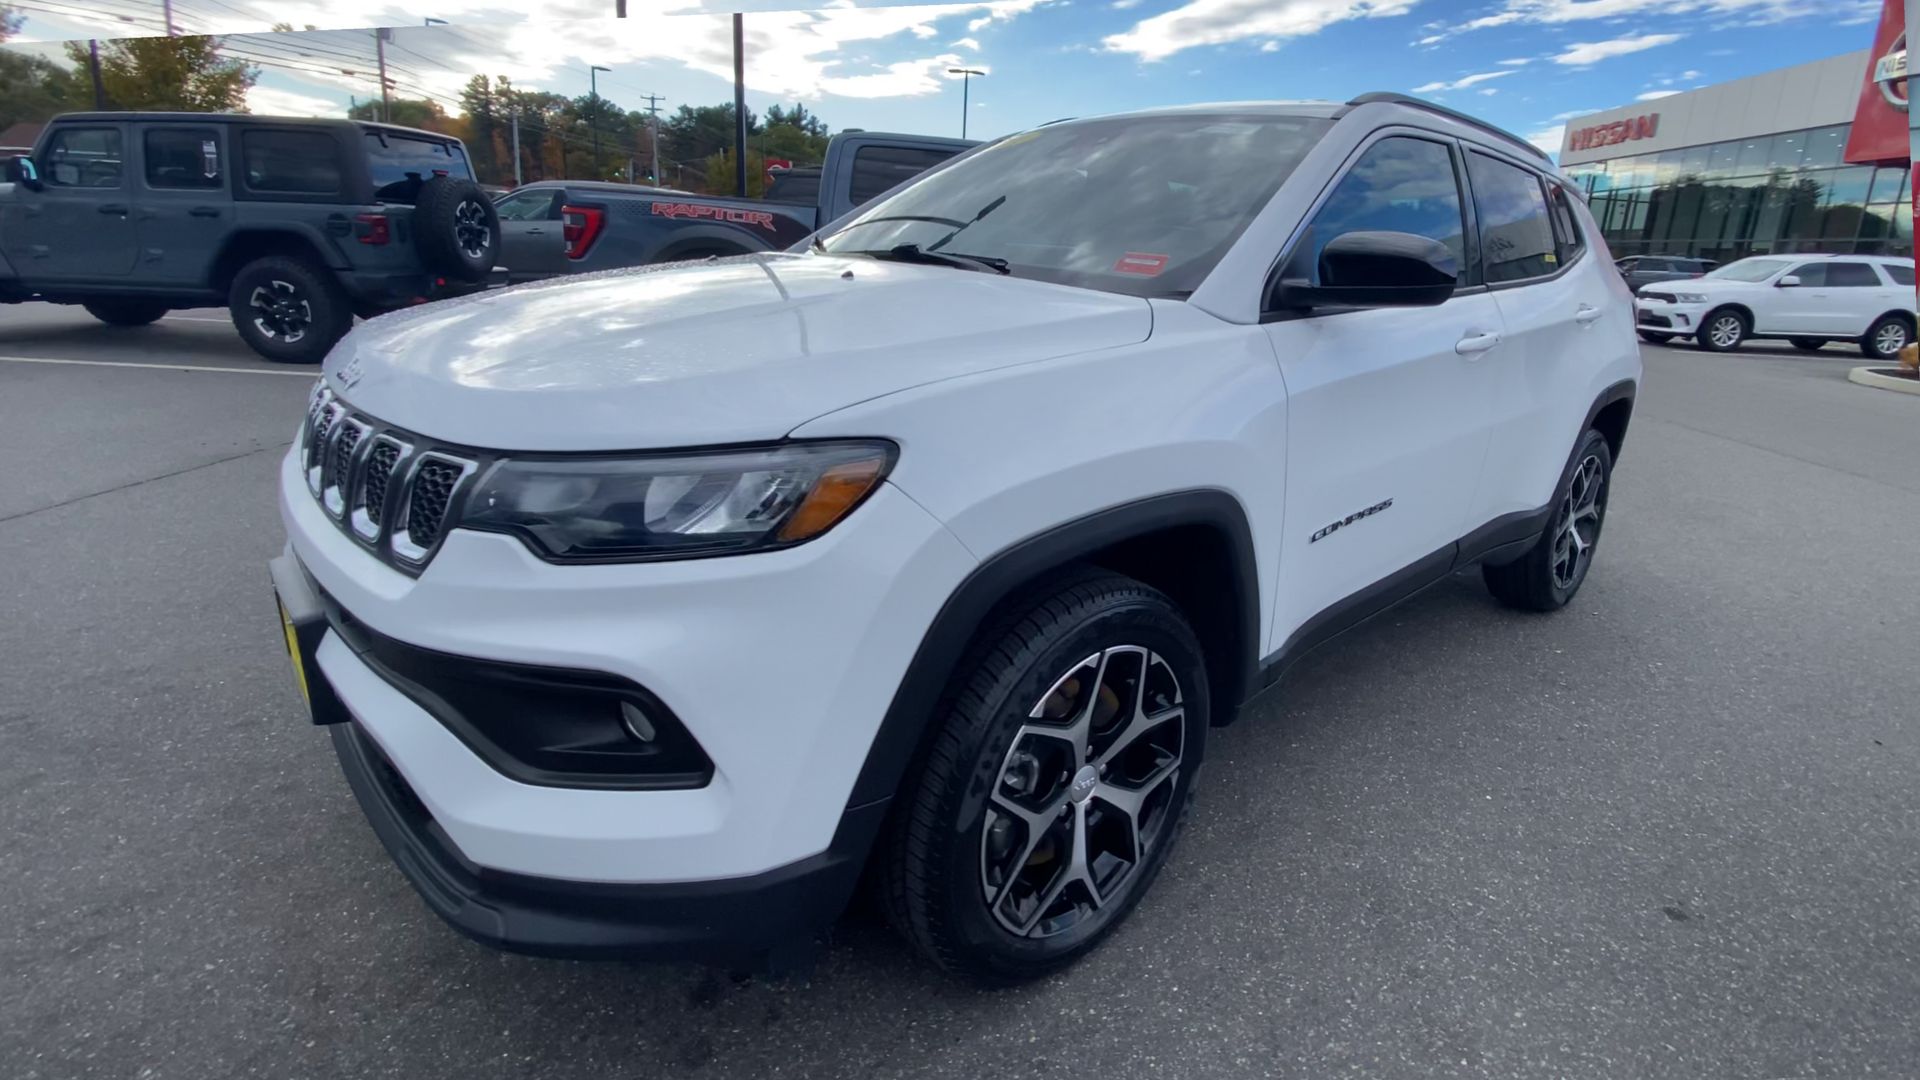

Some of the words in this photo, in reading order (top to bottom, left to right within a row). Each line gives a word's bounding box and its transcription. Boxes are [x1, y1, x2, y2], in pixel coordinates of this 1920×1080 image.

[1568, 112, 1660, 152] NISSAN
[651, 202, 777, 232] RAPTOR
[1309, 497, 1394, 544] COMPASS
